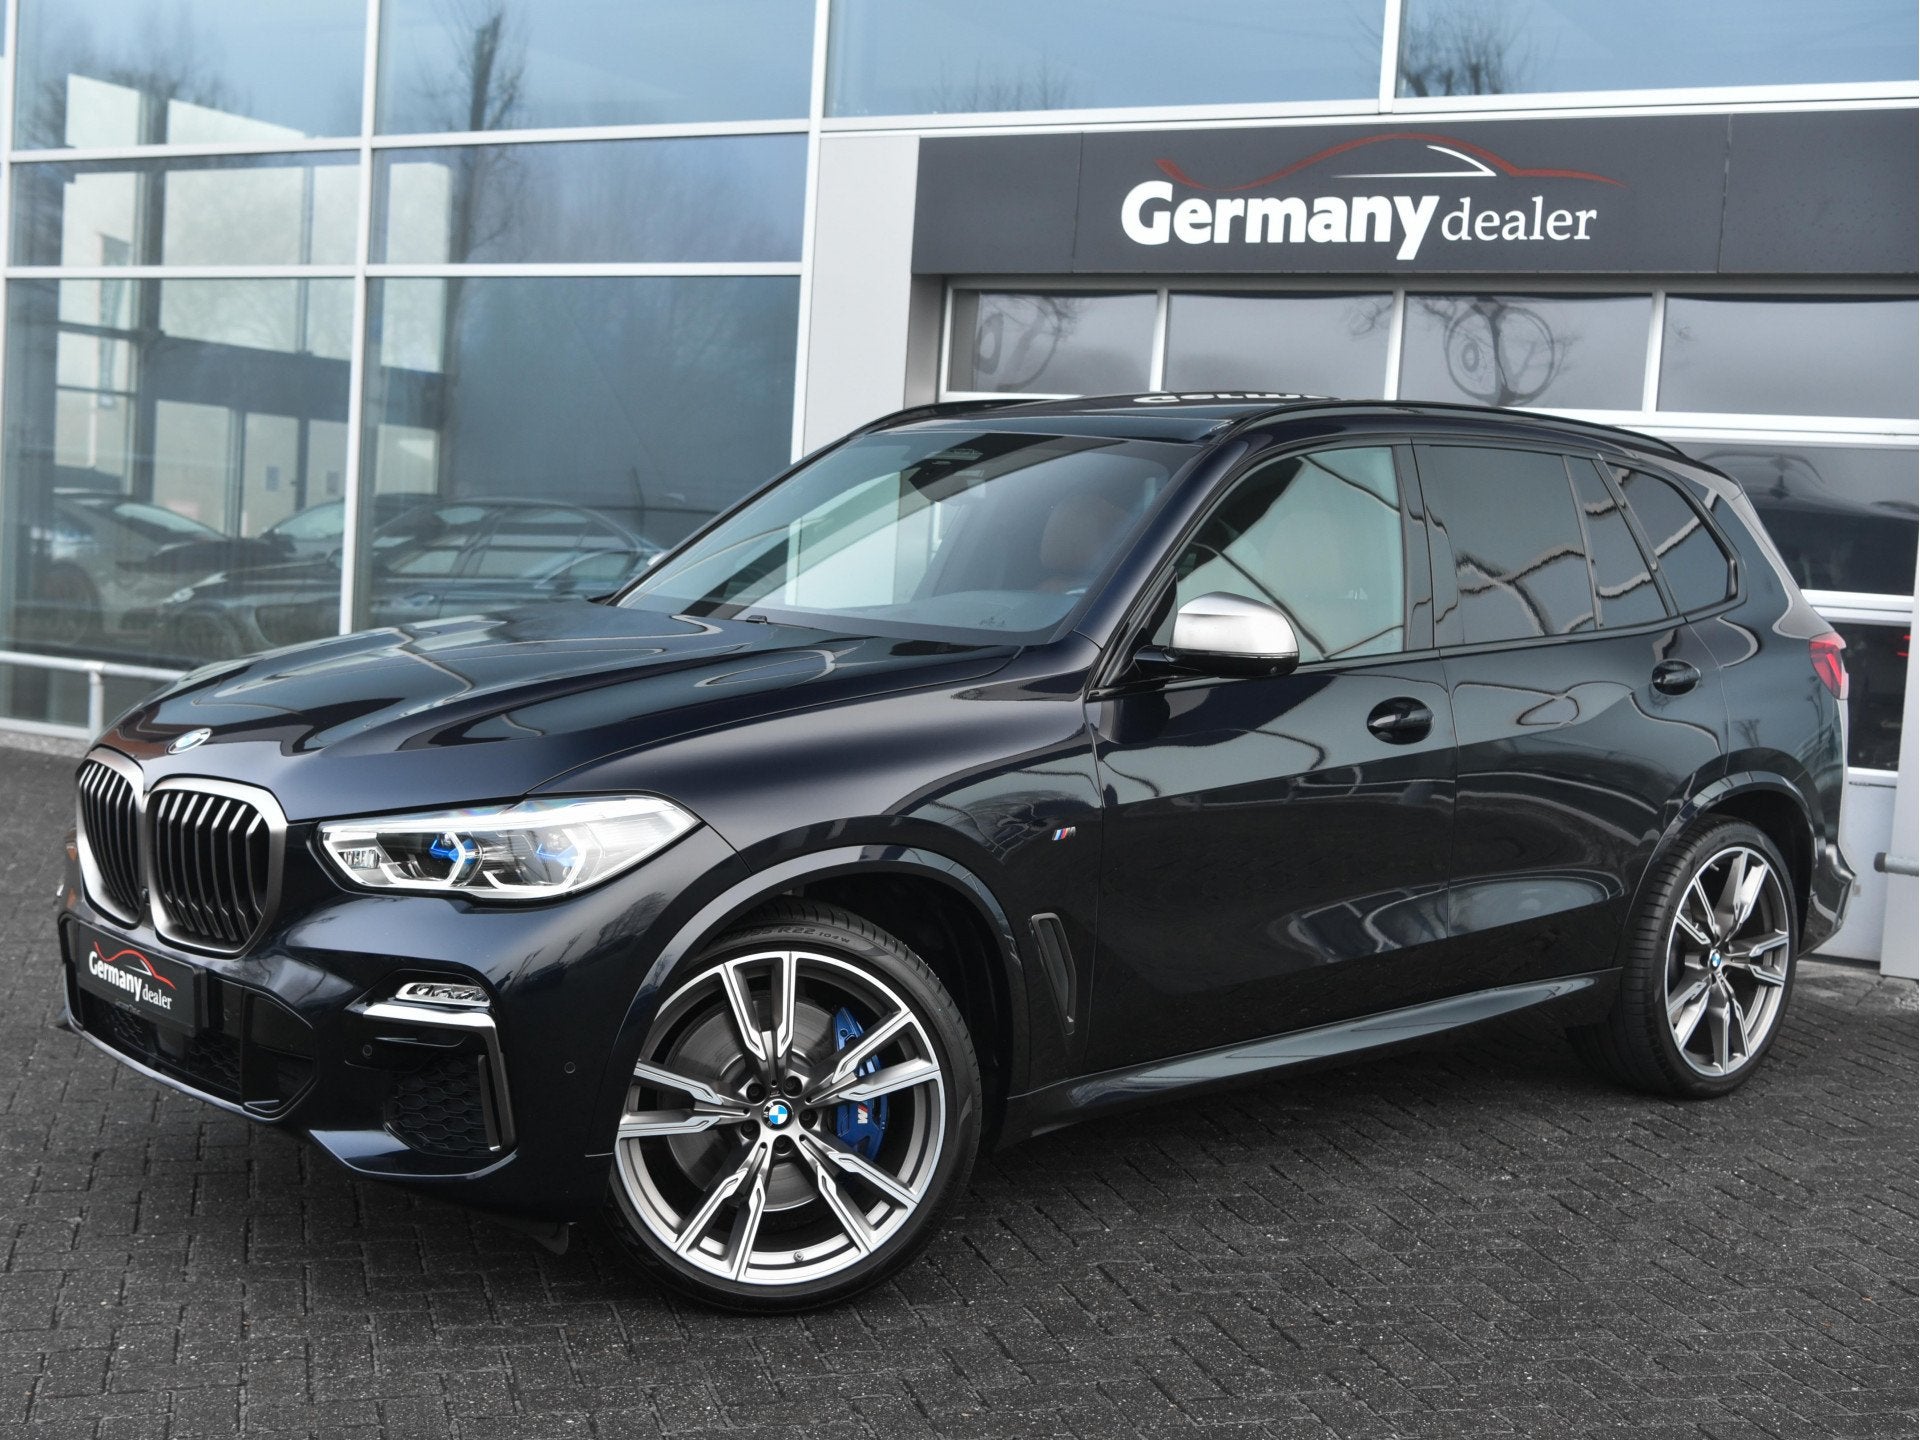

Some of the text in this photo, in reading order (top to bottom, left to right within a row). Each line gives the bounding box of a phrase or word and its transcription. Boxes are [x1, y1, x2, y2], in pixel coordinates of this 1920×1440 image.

[1121, 180, 1597, 260] Germany dealer
[89, 951, 142, 1001] Germany
[142, 984, 172, 1010] dealer
